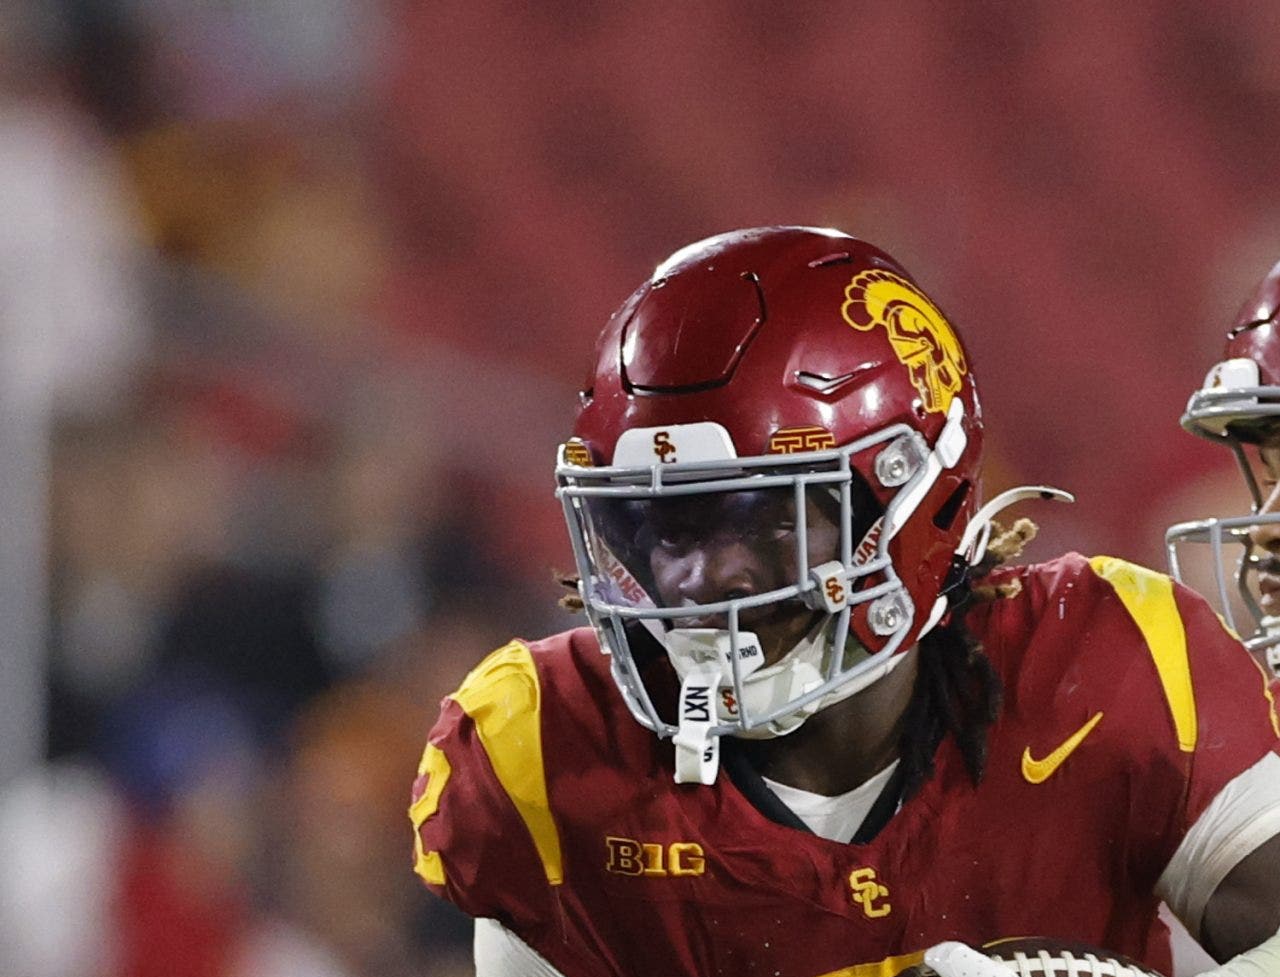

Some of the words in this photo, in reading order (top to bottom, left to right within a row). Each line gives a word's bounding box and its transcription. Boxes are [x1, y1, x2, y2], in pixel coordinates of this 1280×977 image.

[653, 431, 677, 463] SC
[825, 576, 845, 604] SC
[849, 867, 892, 918] SC
